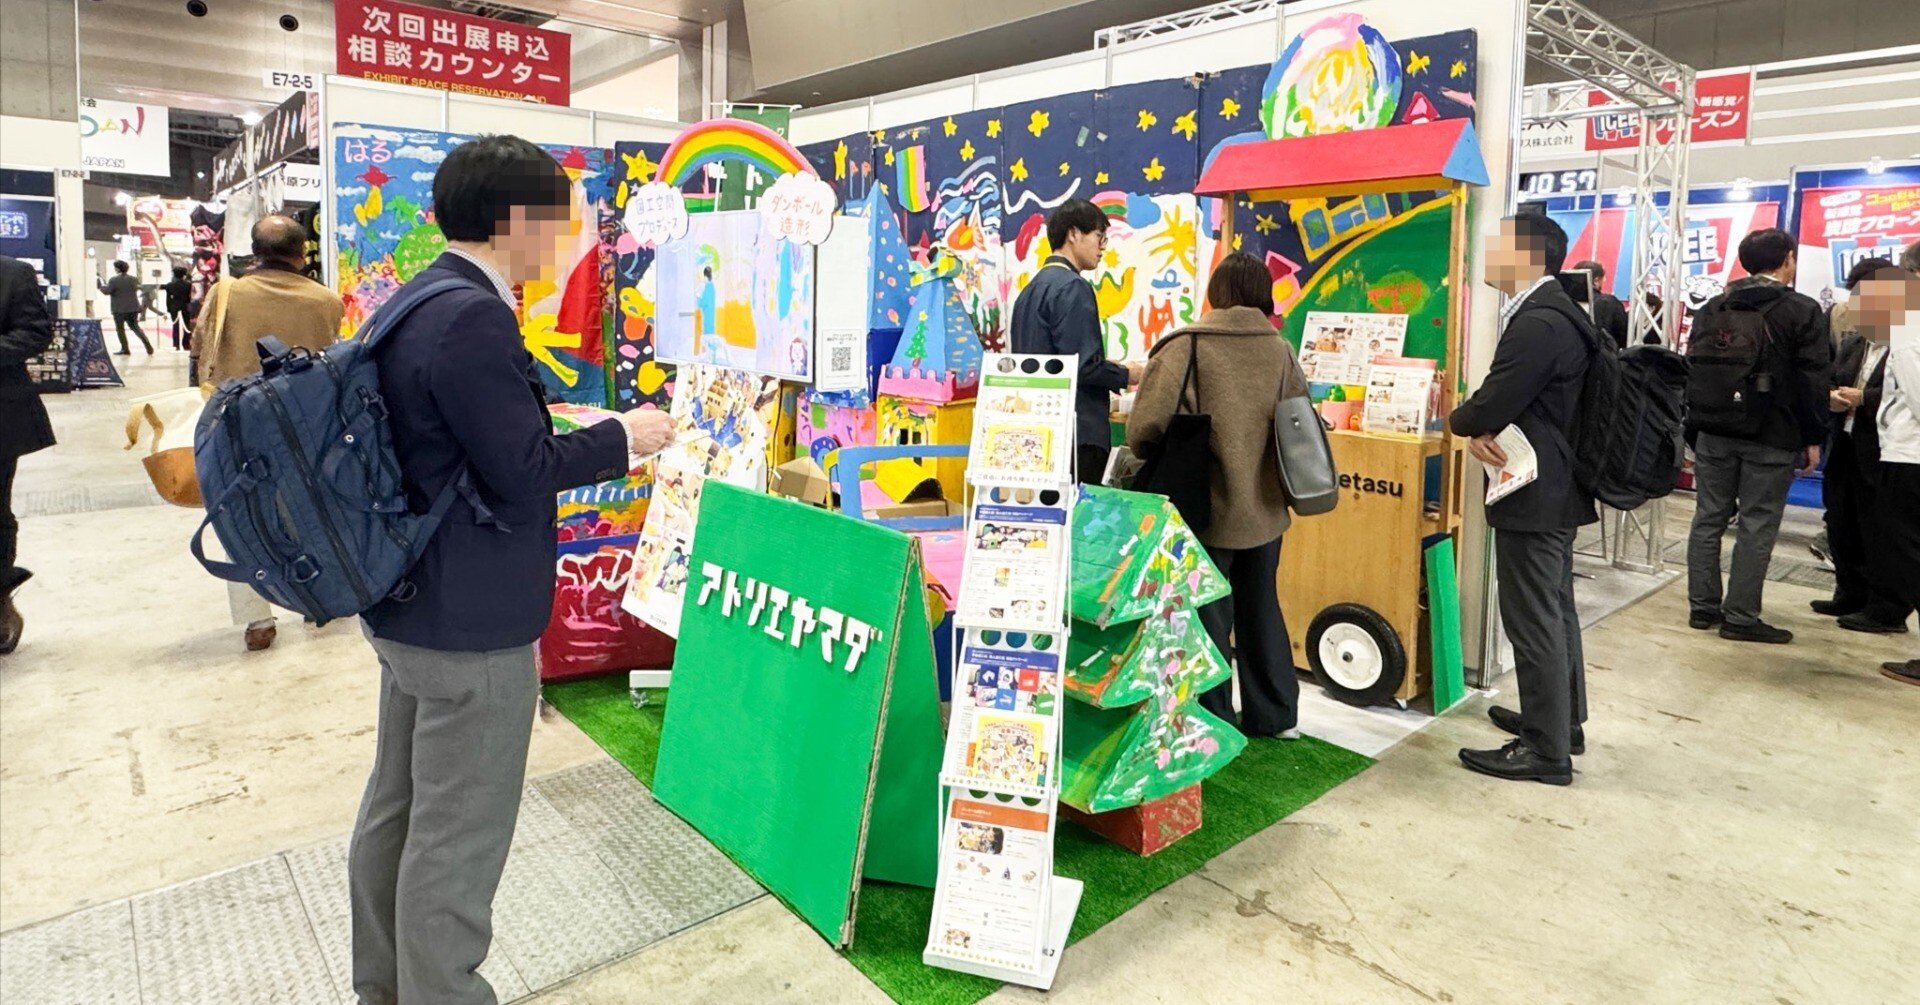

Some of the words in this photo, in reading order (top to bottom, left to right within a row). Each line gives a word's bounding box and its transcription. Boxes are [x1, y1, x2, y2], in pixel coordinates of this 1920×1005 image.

[362, 6, 550, 61] 次回出展申込
[348, 34, 562, 84] 相談カウンター
[272, 72, 313, 89] E7-2-5
[363, 71, 409, 86] EXHIBIT
[411, 77, 449, 92] SPACE
[451, 83, 524, 102] RESERVATION
[83, 156, 125, 168] JAPAN
[344, 139, 393, 164] はる
[771, 194, 824, 216] ダンボール
[697, 561, 883, 673] アトリエヤマダ
